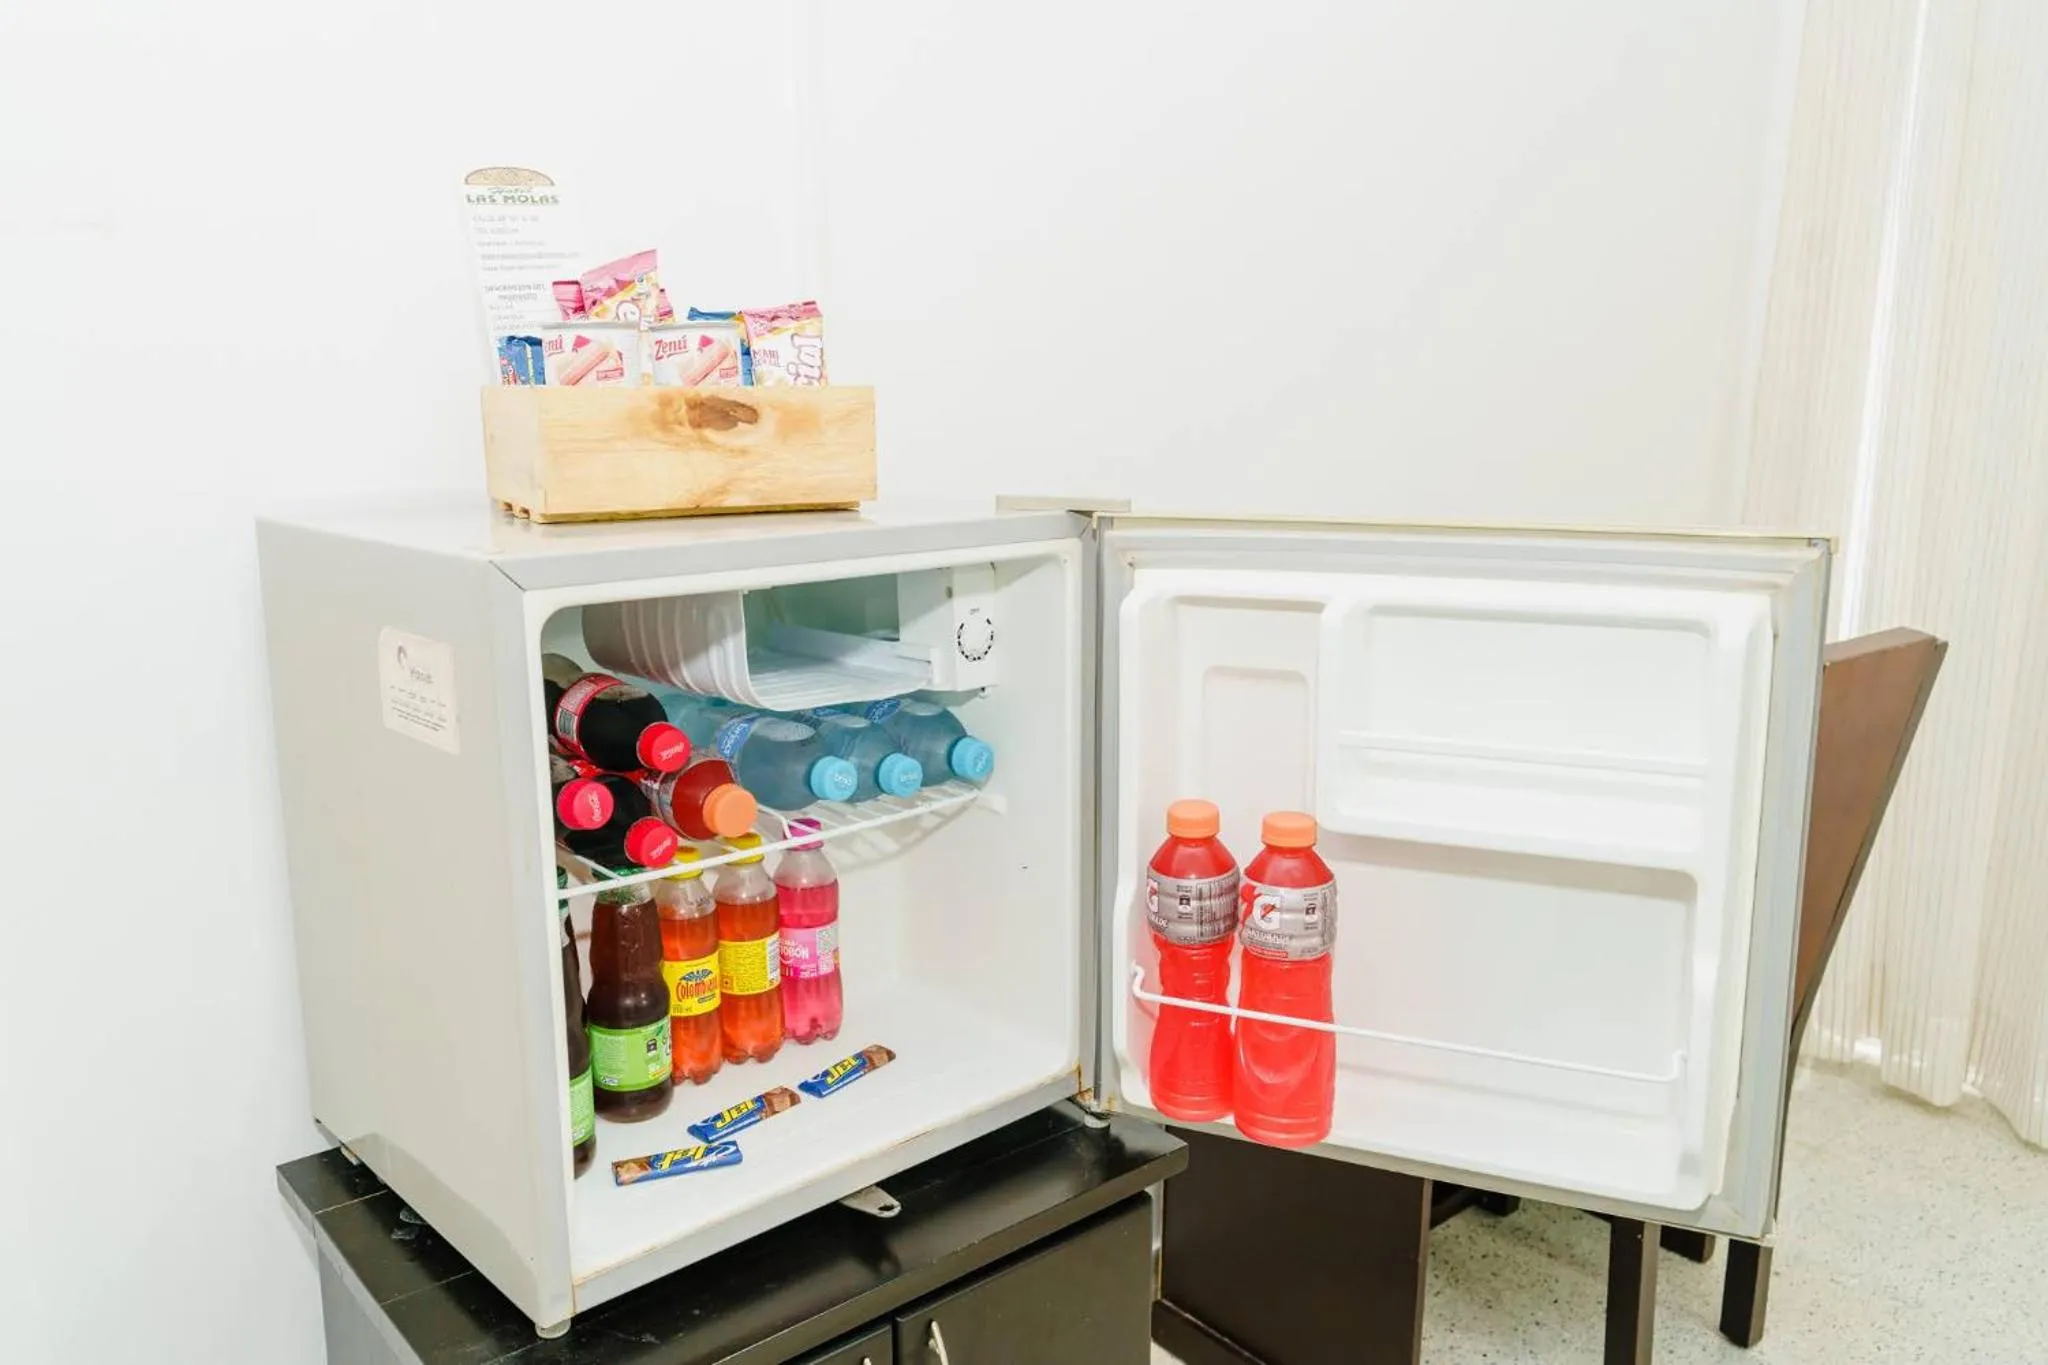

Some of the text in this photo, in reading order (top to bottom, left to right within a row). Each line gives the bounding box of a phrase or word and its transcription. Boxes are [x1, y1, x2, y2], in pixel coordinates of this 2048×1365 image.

[467, 194, 560, 206] LAS MOLAS
[654, 335, 688, 361] Zenú
